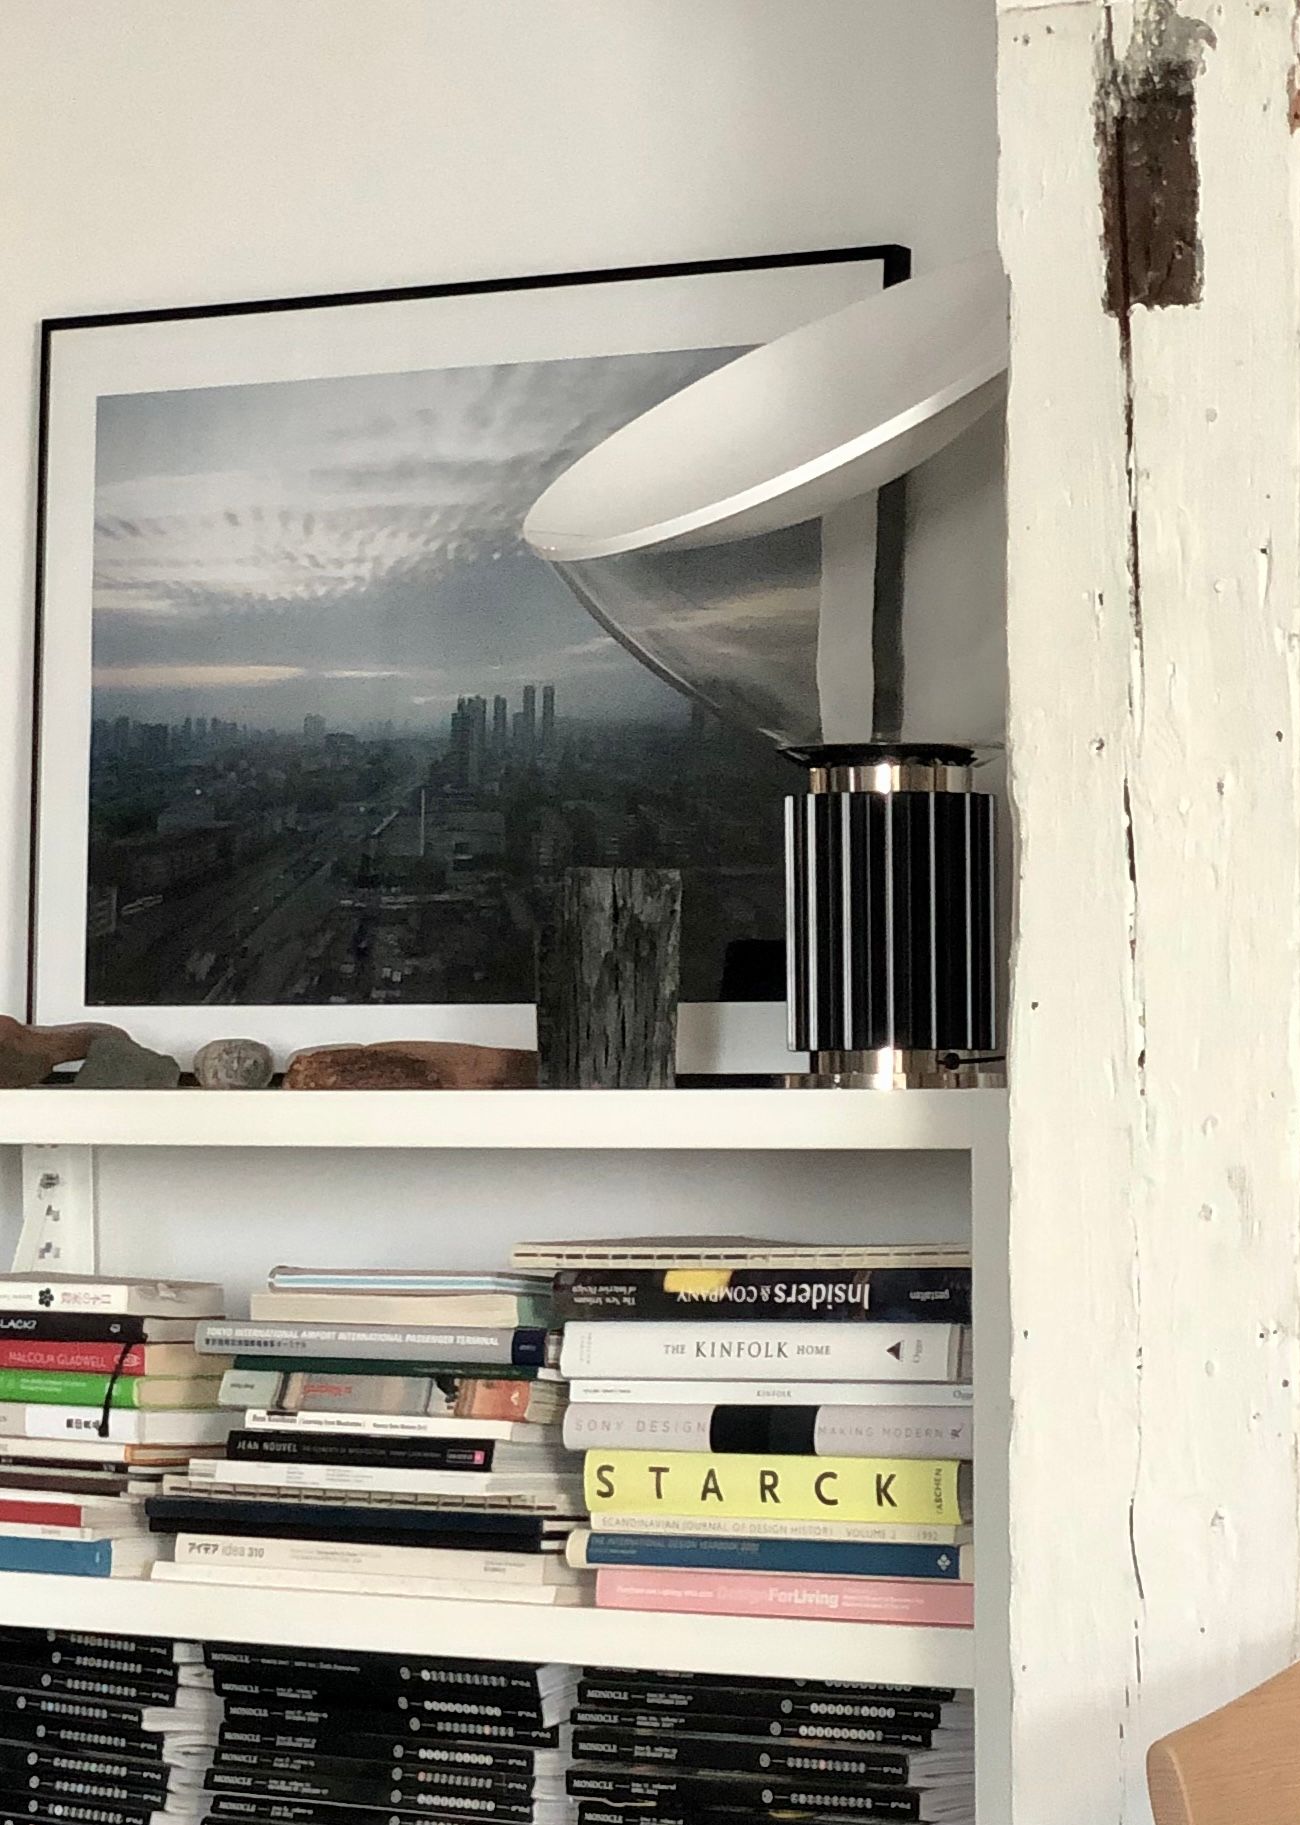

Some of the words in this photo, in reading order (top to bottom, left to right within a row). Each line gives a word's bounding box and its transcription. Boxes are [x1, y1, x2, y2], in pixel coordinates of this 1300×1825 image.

[676, 1284, 758, 1303] COMPANY
[774, 1282, 870, 1310] Insiders
[663, 1344, 687, 1355] THE
[695, 1340, 789, 1359] KINFOLK
[796, 1344, 832, 1356] HOME
[575, 1418, 624, 1432] SONY
[636, 1420, 707, 1433] DESIGN
[818, 1426, 873, 1438] MAKING
[882, 1427, 944, 1439] MODERN
[237, 1440, 260, 1450] JEAN
[263, 1440, 298, 1453] NOUVEL
[596, 1464, 897, 1507] STARCK
[933, 1467, 943, 1515] TASCHEN
[602, 1516, 680, 1530] SCANDINAVIAN
[732, 1519, 746, 1531] OF
[750, 1520, 787, 1534] DESIGN
[790, 1523, 833, 1536] HISTORY
[846, 1527, 886, 1539] VOLUME
[211, 1652, 250, 1664] MONOCLE
[221, 1683, 259, 1694] MONOCLE
[586, 1689, 629, 1700] MONOCLE
[229, 1706, 269, 1717] MONOCLE
[577, 1713, 620, 1724] MONOCLE
[224, 1731, 261, 1743] MONOCLE
[578, 1742, 618, 1753] MONOCLE
[221, 1752, 258, 1764] MONOCLE
[213, 1774, 253, 1786] MONOCLE
[573, 1779, 614, 1790] MONOCLE
[219, 1801, 256, 1813] MONOCLE
[584, 1812, 623, 1824] MONOCLE
